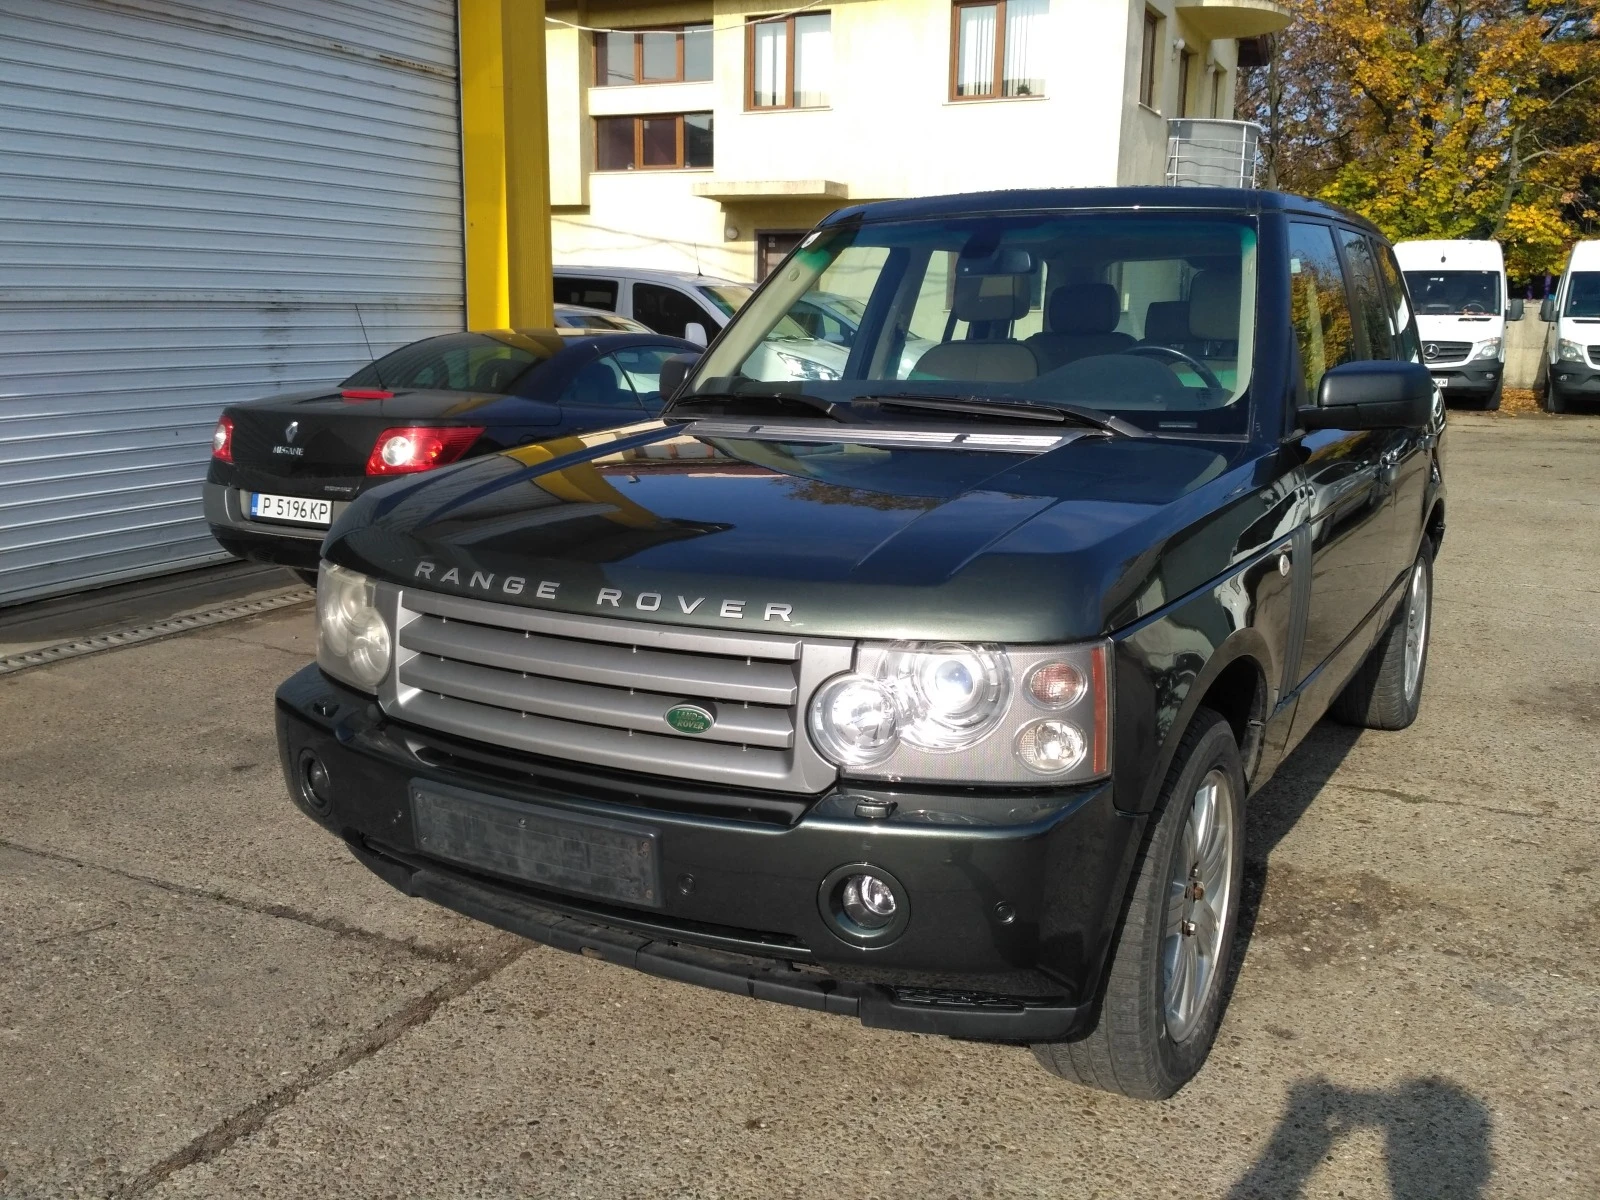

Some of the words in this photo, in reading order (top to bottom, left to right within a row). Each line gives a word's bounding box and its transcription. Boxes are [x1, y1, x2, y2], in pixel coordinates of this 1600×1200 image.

[414, 561, 561, 600] RANGE
[596, 587, 794, 623] ROVER
[676, 710, 698, 721] LAND
[676, 720, 705, 730] ROVER
